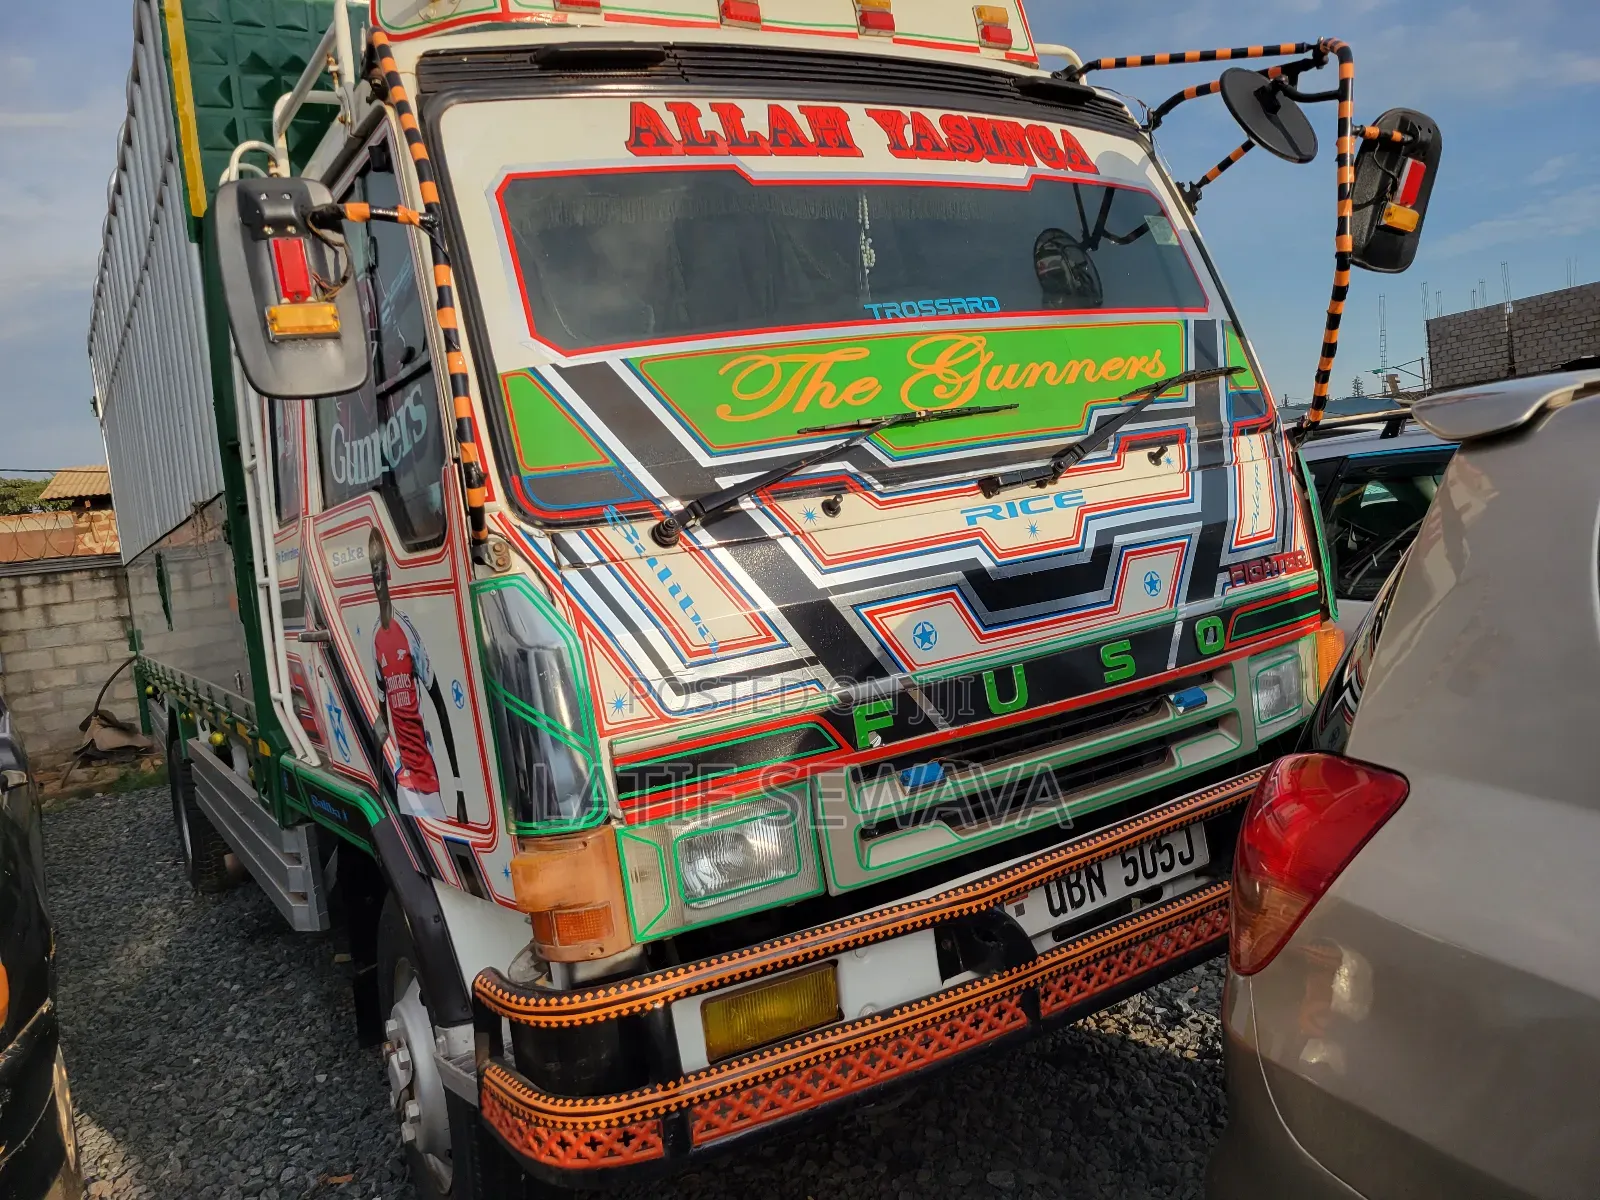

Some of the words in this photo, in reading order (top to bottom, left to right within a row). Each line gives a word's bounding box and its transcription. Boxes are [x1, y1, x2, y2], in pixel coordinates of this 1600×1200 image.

[627, 101, 864, 158] ALLAH
[865, 107, 1100, 174] YASINGA
[863, 296, 1001, 321] TROSSARD
[715, 345, 882, 422] The
[900, 333, 1167, 413] Gunners
[330, 383, 427, 485] Gunners
[960, 489, 1087, 527] RICE
[331, 546, 365, 568] Saka
[1228, 550, 1313, 588] FIGHTER
[852, 615, 1225, 750] FUSO
[1044, 862, 1107, 918] UBN
[1120, 827, 1195, 887] 505J
